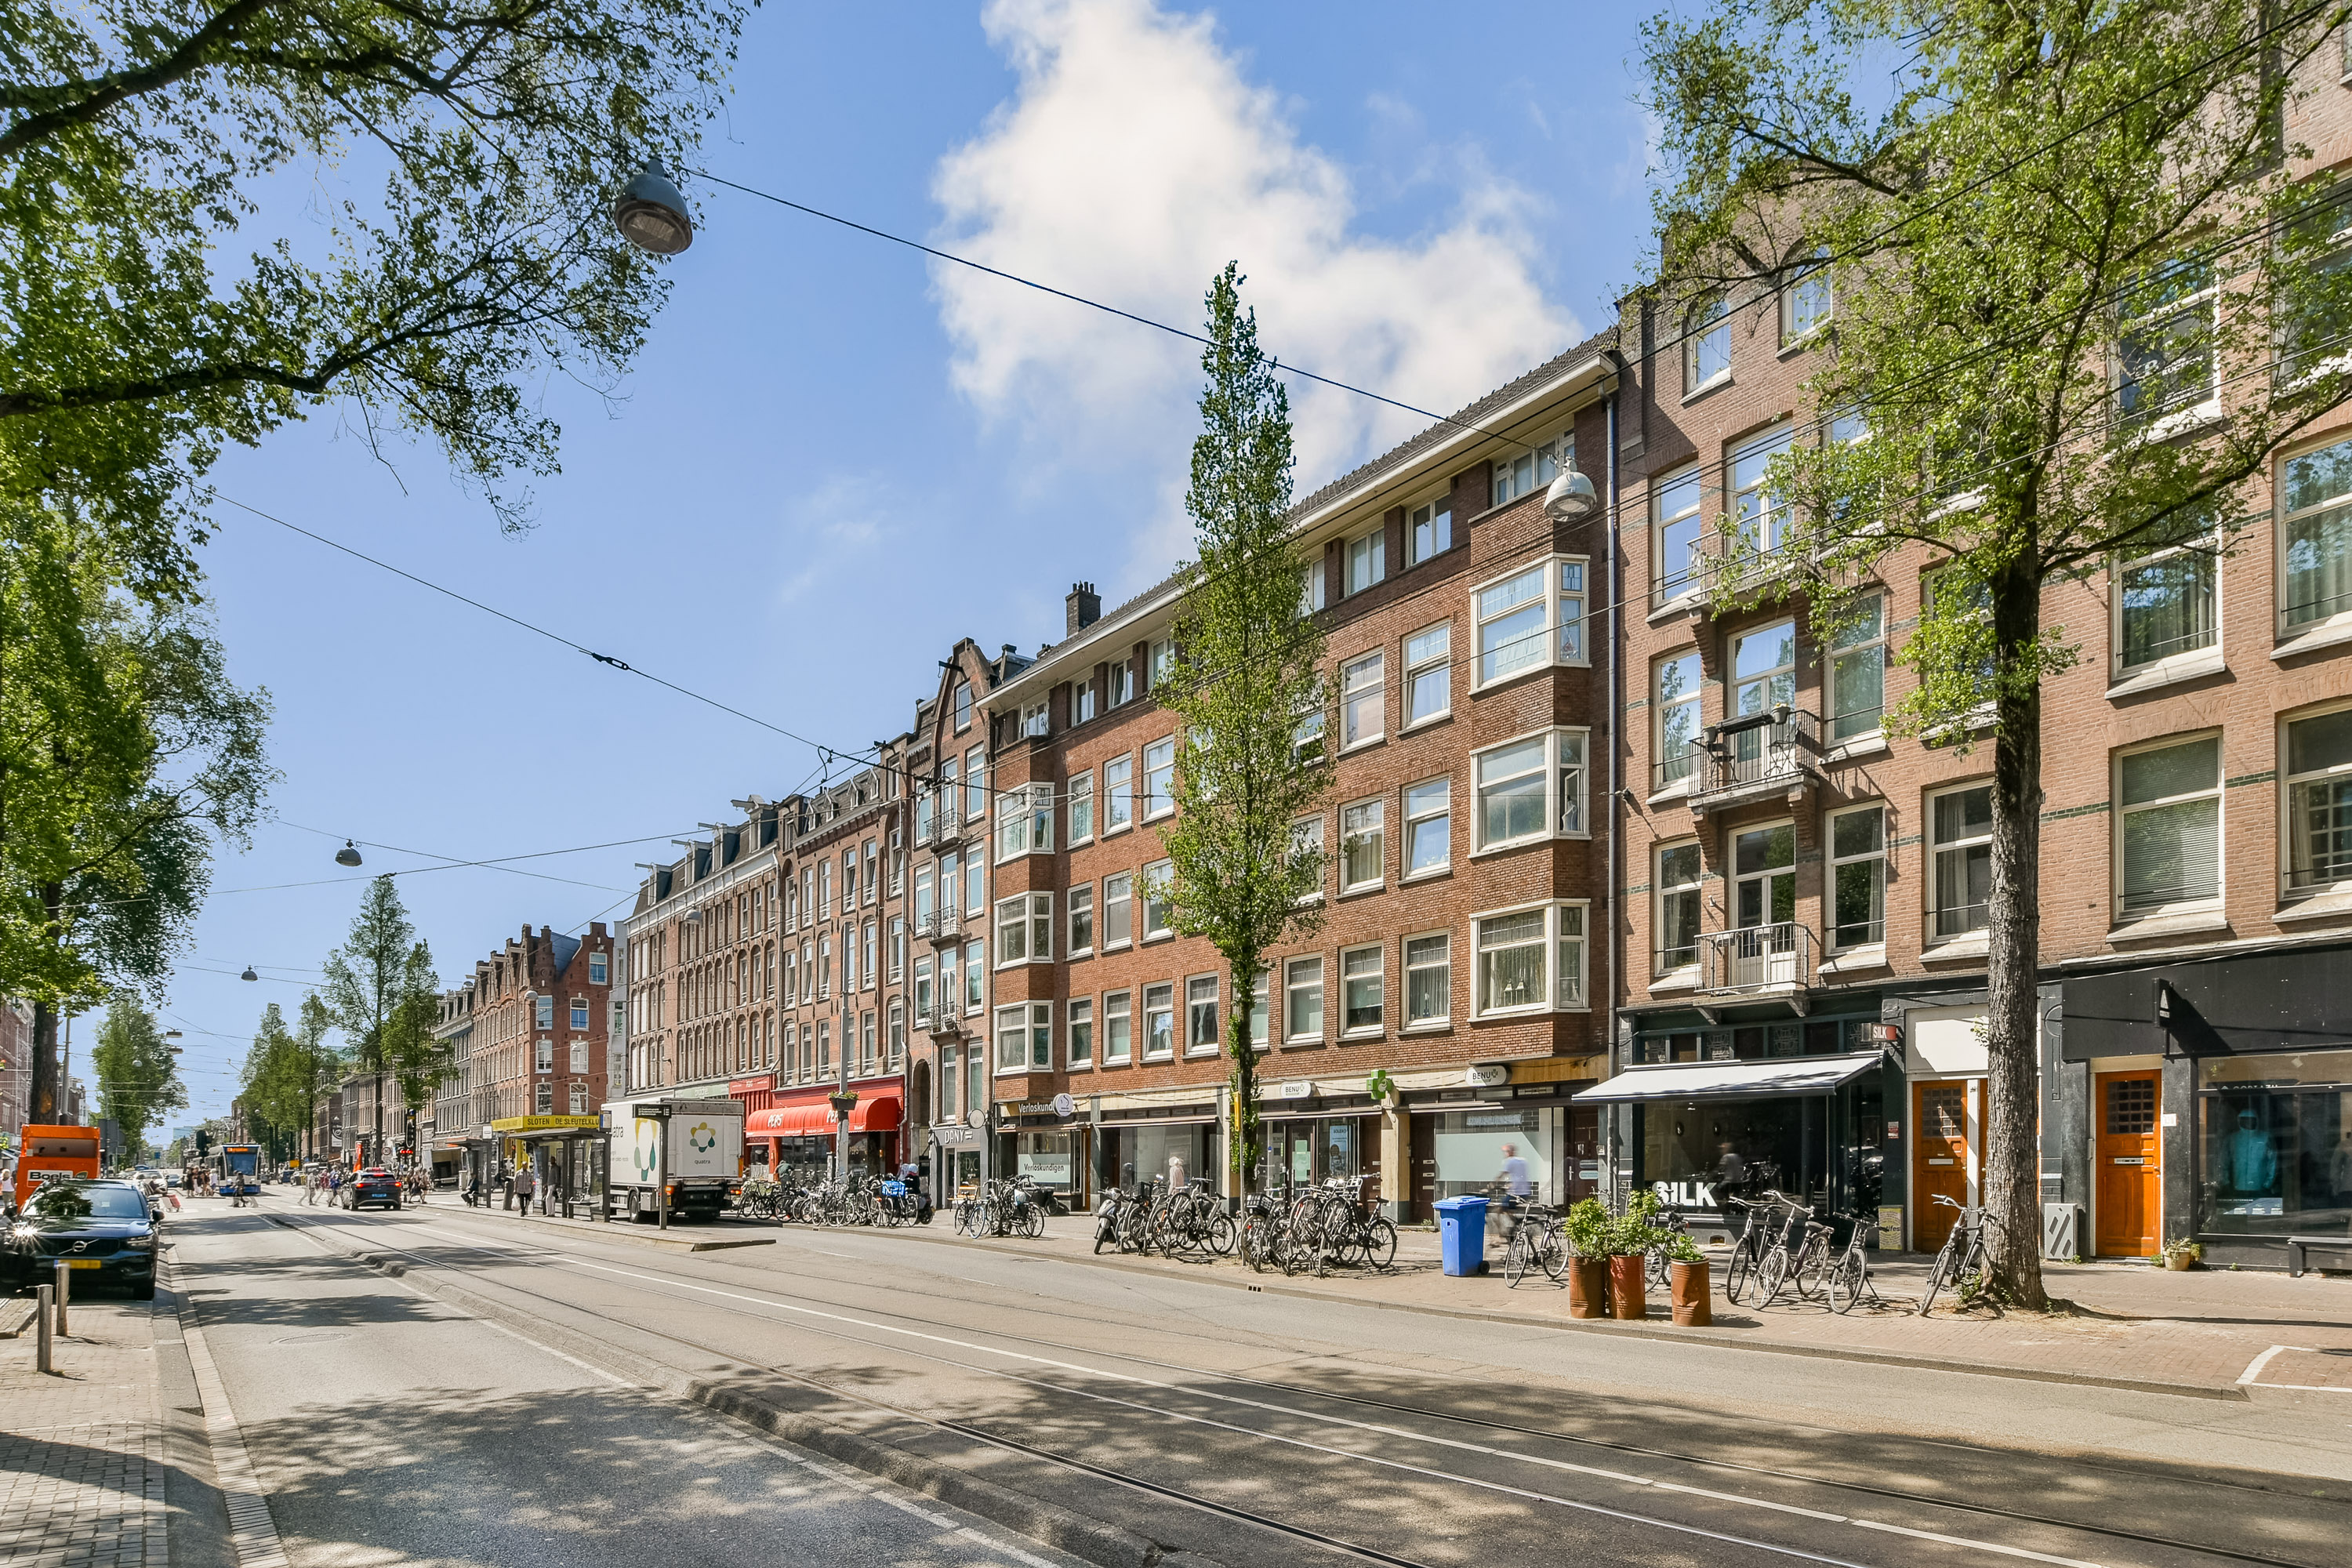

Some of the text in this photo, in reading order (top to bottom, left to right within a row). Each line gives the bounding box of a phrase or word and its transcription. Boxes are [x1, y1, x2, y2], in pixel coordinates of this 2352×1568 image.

[1874, 1025, 1887, 1039] SILK
[1472, 1071, 1490, 1080] BENU
[1018, 1102, 1054, 1112] Verloskund
[768, 1114, 783, 1127] PEPS
[826, 1109, 839, 1123] PEP
[612, 1125, 623, 1138] atra
[945, 1130, 964, 1143] DANY
[1024, 1163, 1064, 1173] Verloskundigen
[1652, 1181, 1718, 1207] SILK
